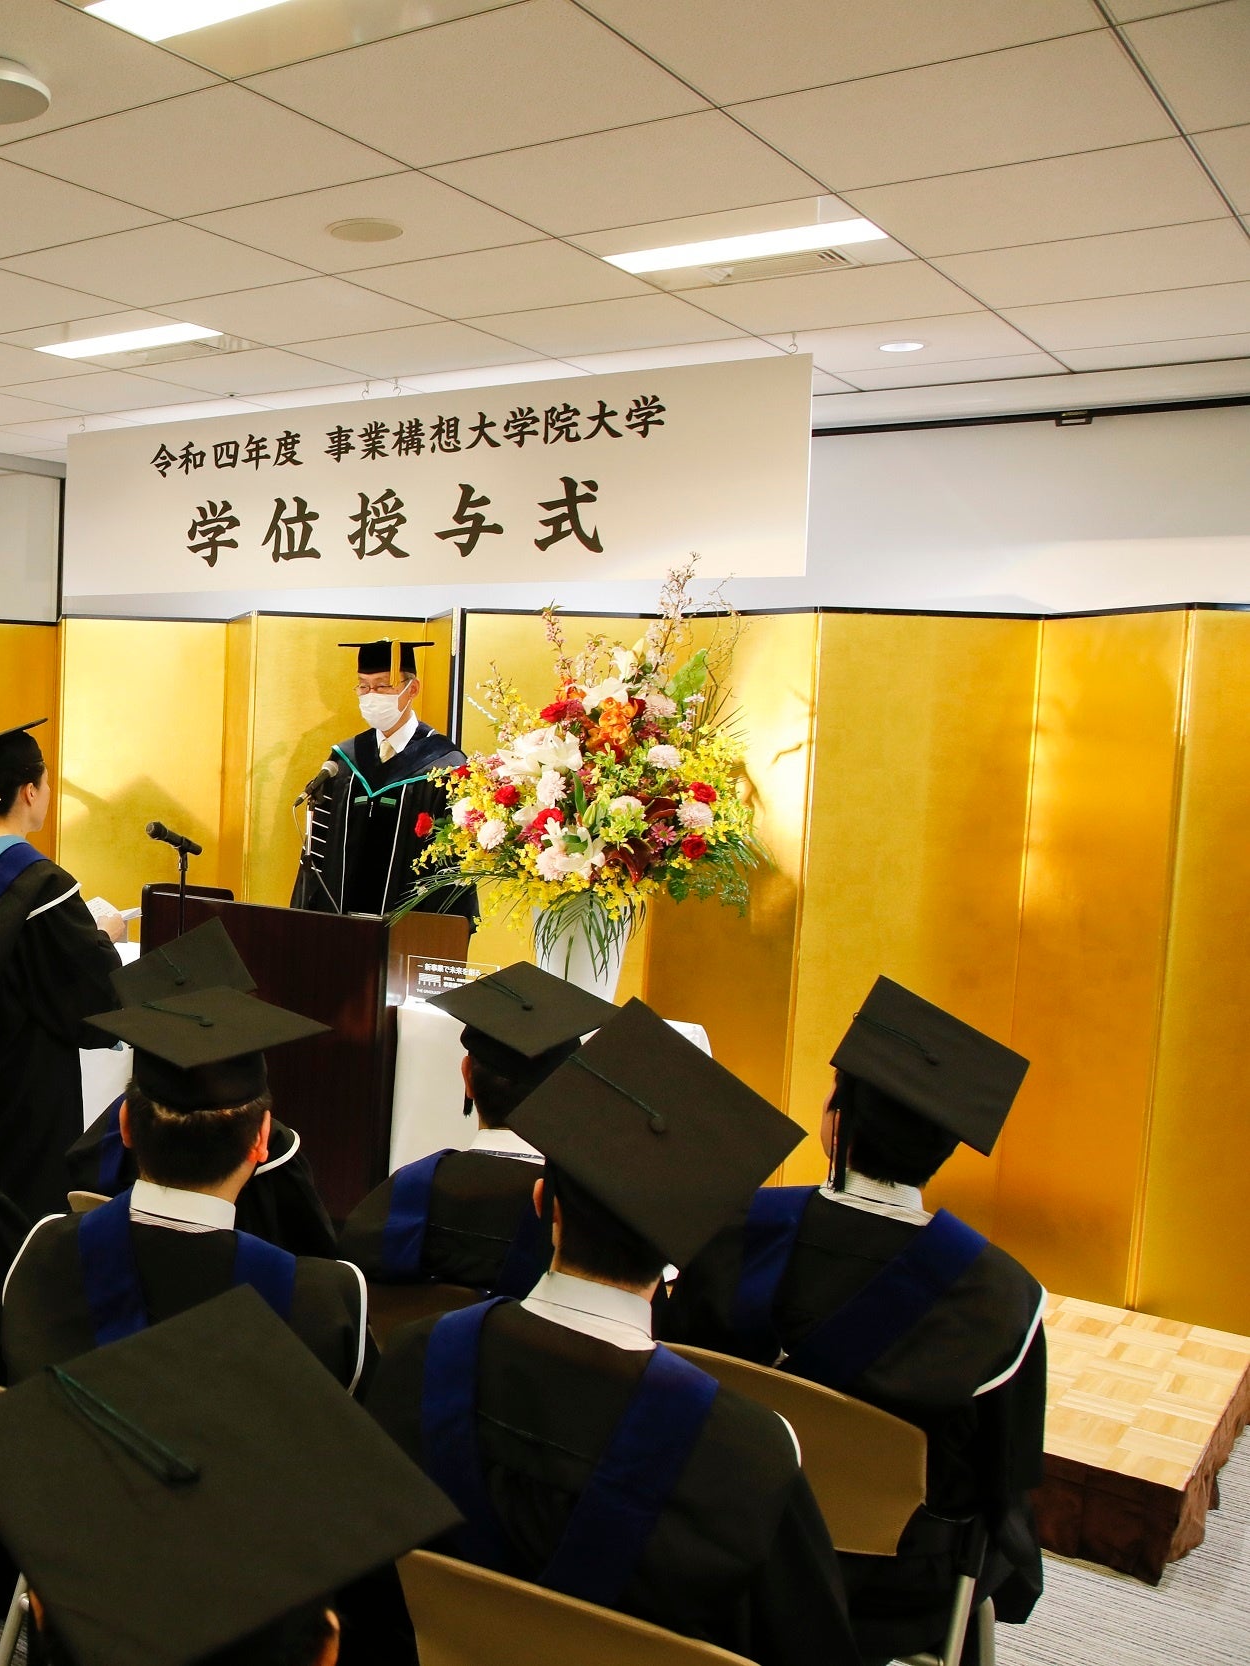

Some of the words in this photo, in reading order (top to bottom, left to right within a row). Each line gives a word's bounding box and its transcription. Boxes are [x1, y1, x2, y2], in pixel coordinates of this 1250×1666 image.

[150, 431, 303, 477] 令和四年度
[324, 395, 666, 462] 事業構想大学院大学
[187, 476, 604, 568] 学位授与式
